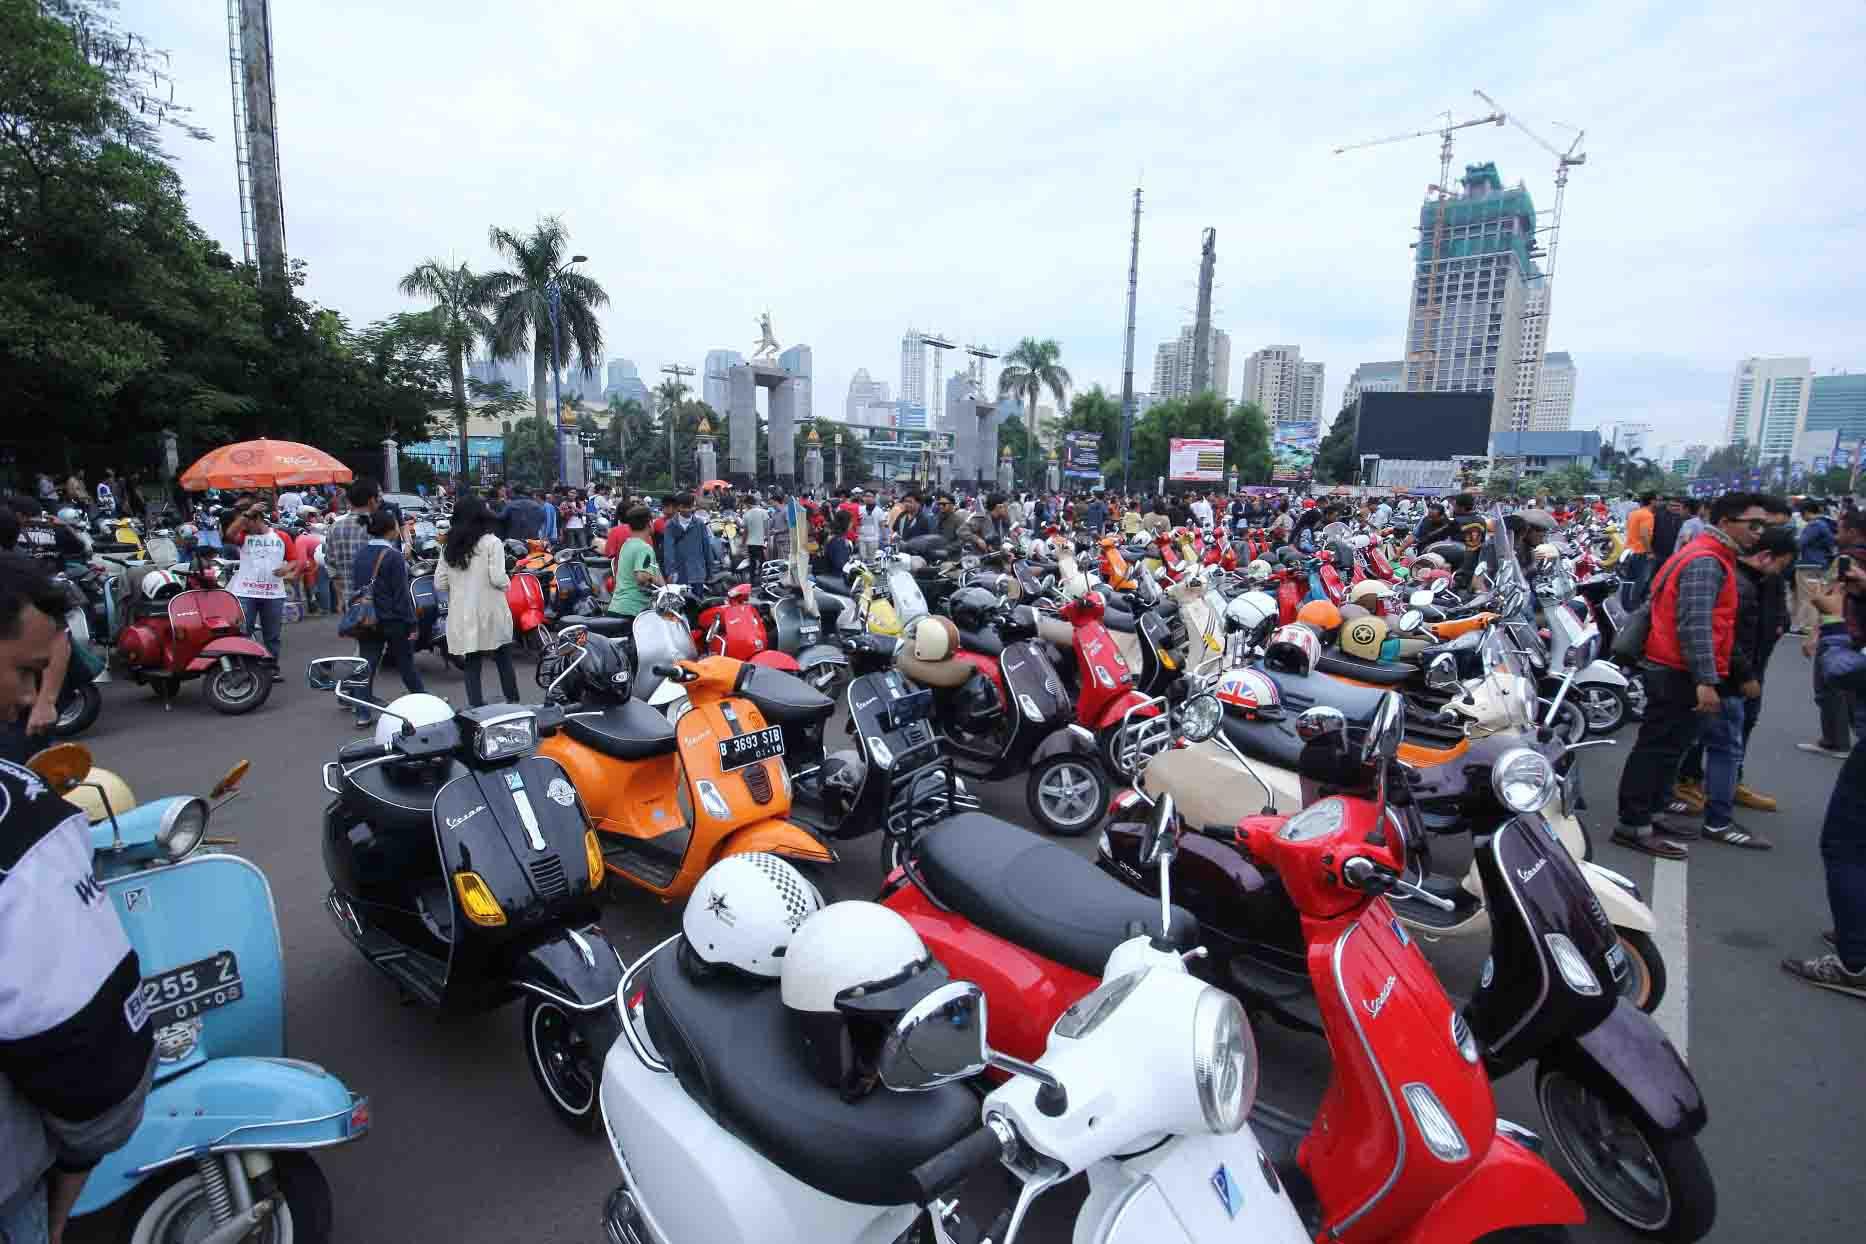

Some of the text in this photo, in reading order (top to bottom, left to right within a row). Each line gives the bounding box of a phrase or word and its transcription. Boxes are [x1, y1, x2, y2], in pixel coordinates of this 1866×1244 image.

[720, 742, 728, 757] B
[733, 735, 758, 753] 3693
[446, 804, 488, 830] Vespa
[1516, 858, 1548, 884] Vespa
[143, 955, 235, 1006] 255 Z
[1362, 975, 1397, 1020] Vespa
